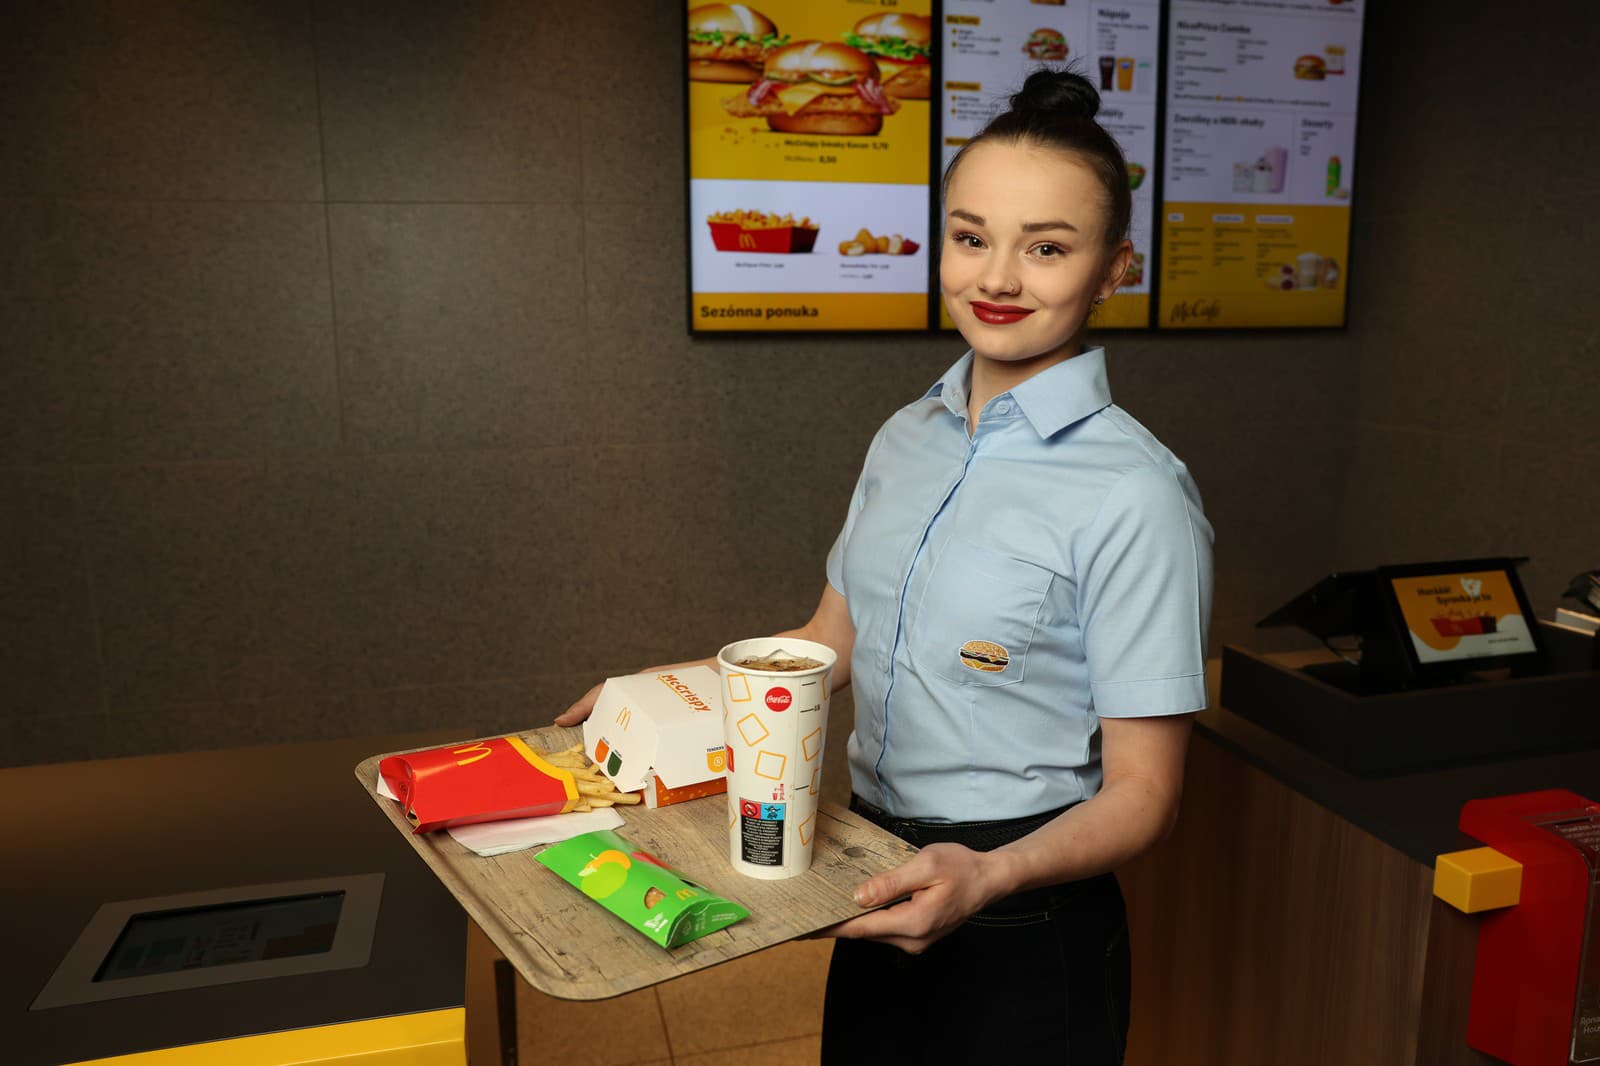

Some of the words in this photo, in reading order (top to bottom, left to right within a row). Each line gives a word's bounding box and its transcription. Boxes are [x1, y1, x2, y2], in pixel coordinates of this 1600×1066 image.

[701, 305, 762, 319] Sezónna
[766, 305, 819, 321] ponuka
[662, 674, 712, 712] McCrispy
